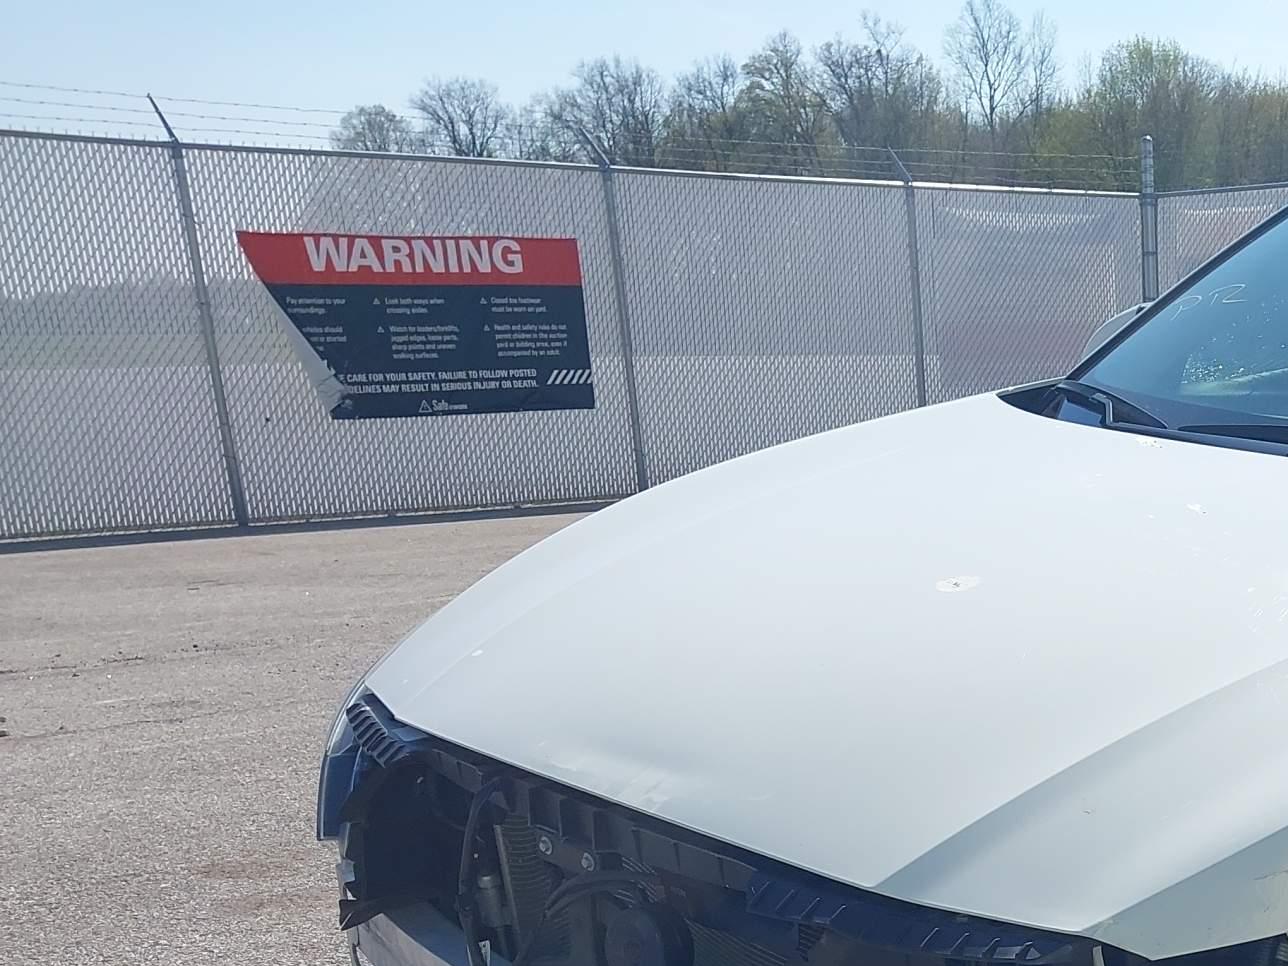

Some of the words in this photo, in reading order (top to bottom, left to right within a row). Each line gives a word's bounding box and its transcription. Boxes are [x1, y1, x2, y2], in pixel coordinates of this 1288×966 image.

[303, 236, 524, 273] WARNING
[347, 373, 368, 382] CARE
[369, 373, 384, 382] FOR
[385, 372, 407, 381] YOUR
[438, 370, 467, 380] FAILURE
[468, 370, 478, 379] TO
[478, 369, 508, 378] FOLLOW
[509, 368, 537, 377] POSTED
[382, 384, 400, 393] MAY
[401, 383, 429, 392] RESULT
[430, 383, 440, 392] IN
[441, 381, 472, 391] SERIOUS
[473, 381, 500, 390] INJURY
[501, 380, 512, 389] OR
